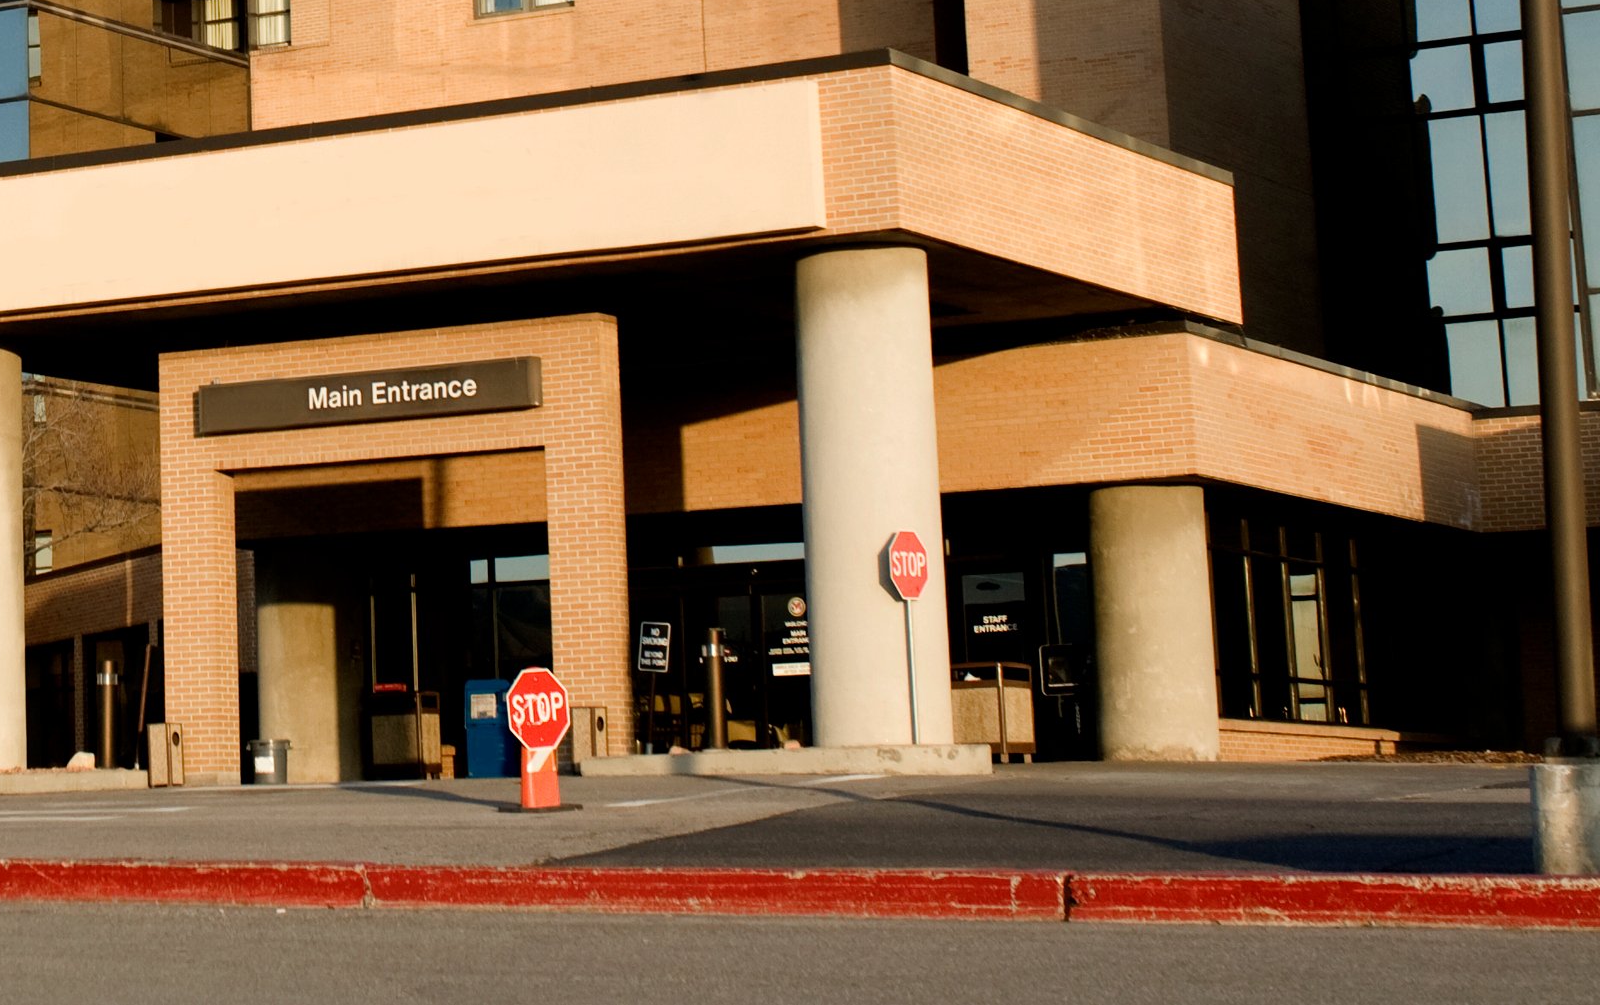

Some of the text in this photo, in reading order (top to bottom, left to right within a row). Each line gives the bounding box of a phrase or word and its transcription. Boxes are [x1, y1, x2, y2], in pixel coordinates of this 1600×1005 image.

[308, 379, 477, 410] Main Entrance
[892, 550, 925, 577] STOP
[983, 615, 1007, 624] STAFF
[651, 628, 660, 637] NO
[973, 623, 1018, 634] ENTRANCE
[641, 636, 668, 646] SMOKING
[512, 691, 564, 726] STOP
